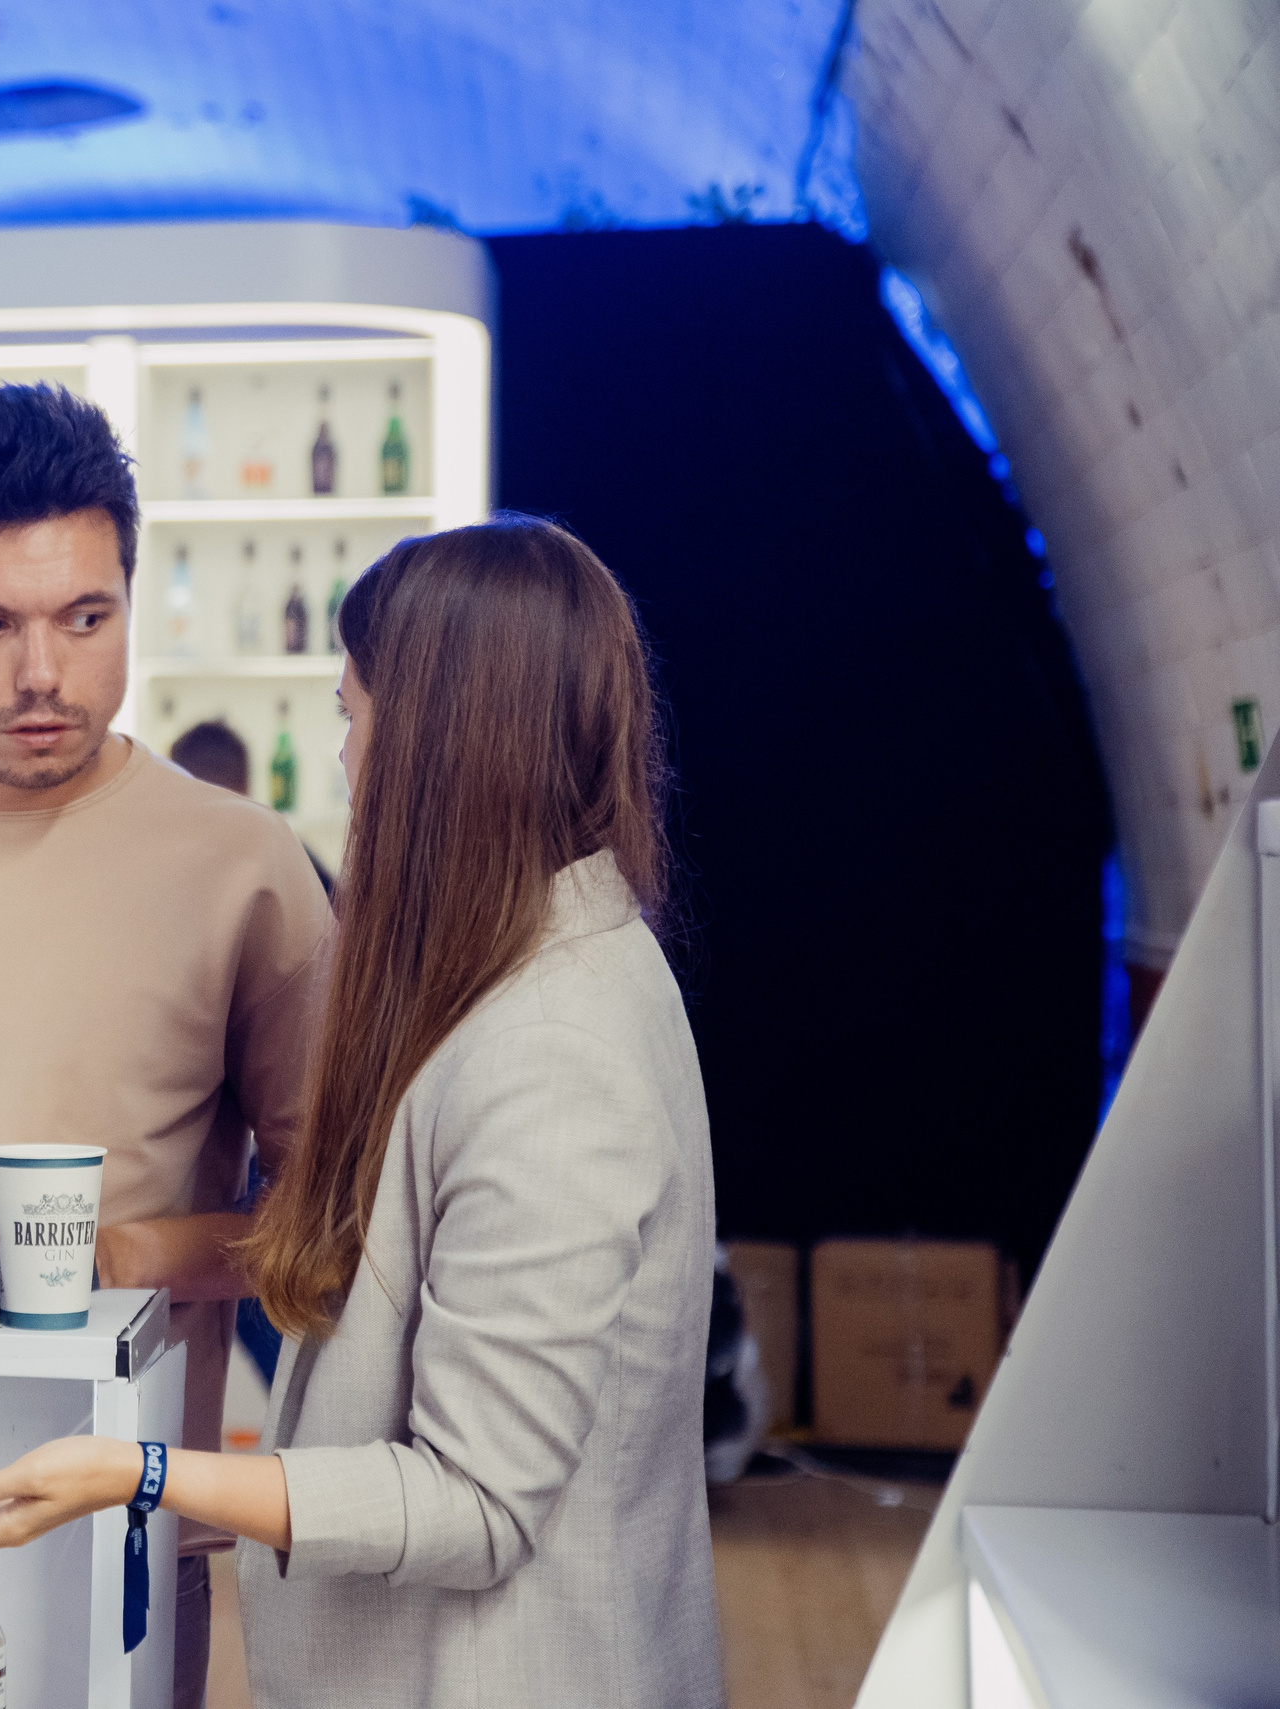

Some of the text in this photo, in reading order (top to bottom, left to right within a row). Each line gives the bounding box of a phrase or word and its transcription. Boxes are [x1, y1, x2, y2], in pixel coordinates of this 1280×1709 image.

[14, 1221, 96, 1247] BARRISTER
[44, 1249, 75, 1262] GIN
[142, 1444, 163, 1495] EXPO
